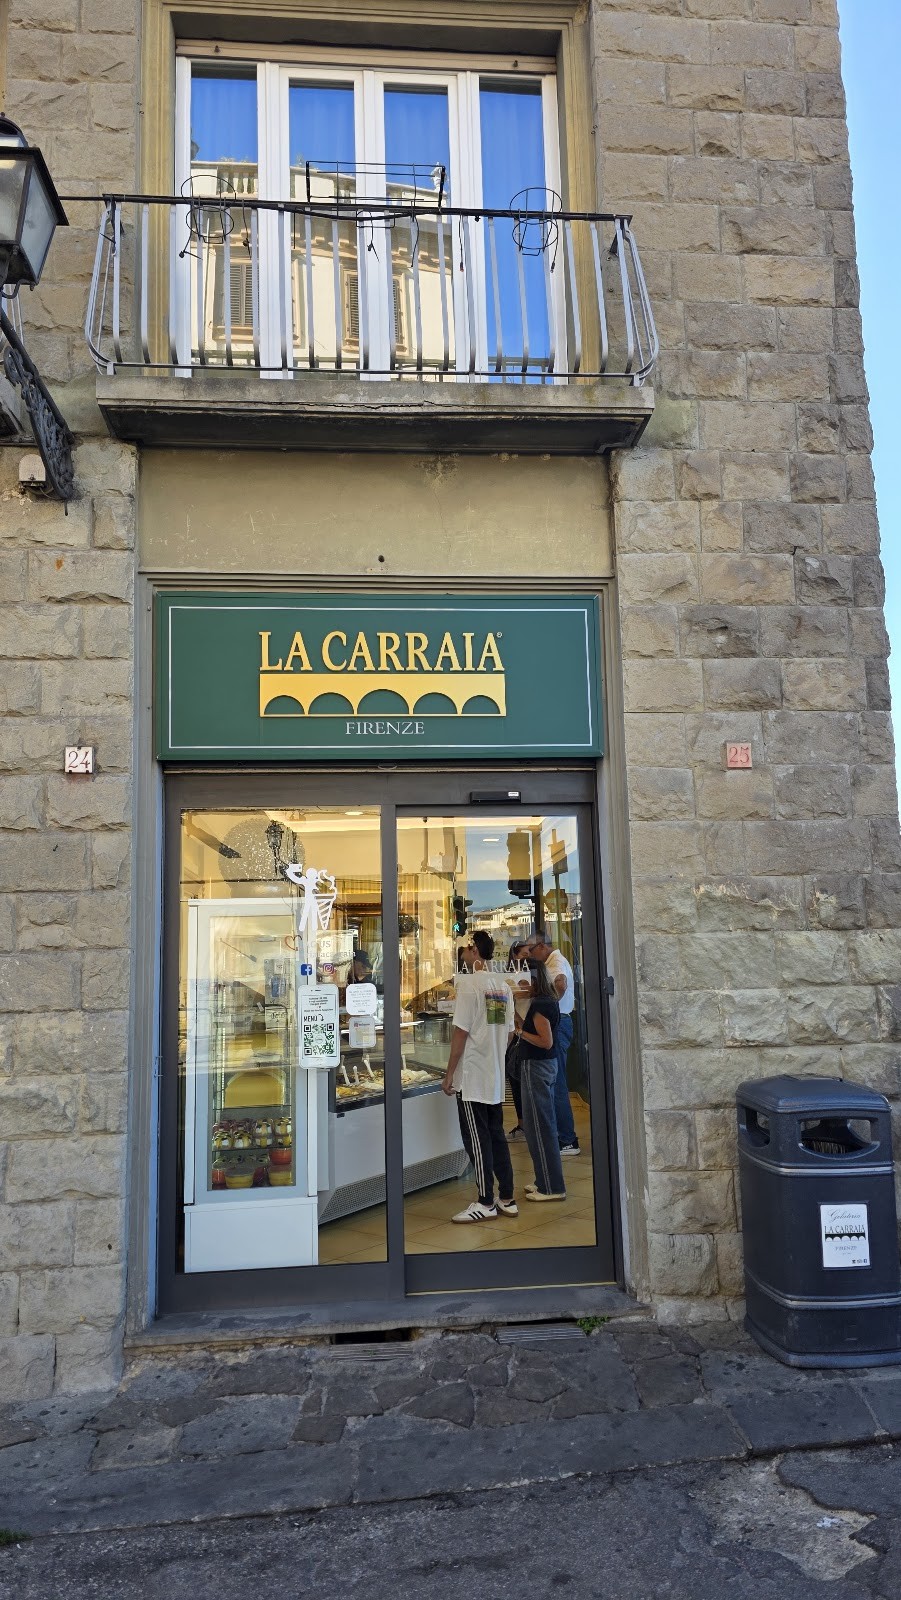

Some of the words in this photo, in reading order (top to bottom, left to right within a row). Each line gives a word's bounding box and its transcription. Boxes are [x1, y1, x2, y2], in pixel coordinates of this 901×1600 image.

[259, 631, 313, 671] LA
[321, 631, 505, 671] CARRAIA
[345, 721, 425, 735] FIRENZE
[68, 750, 90, 769] 24
[729, 746, 750, 764] 25
[453, 961, 469, 973] LA
[473, 959, 530, 973] CARRAIA
